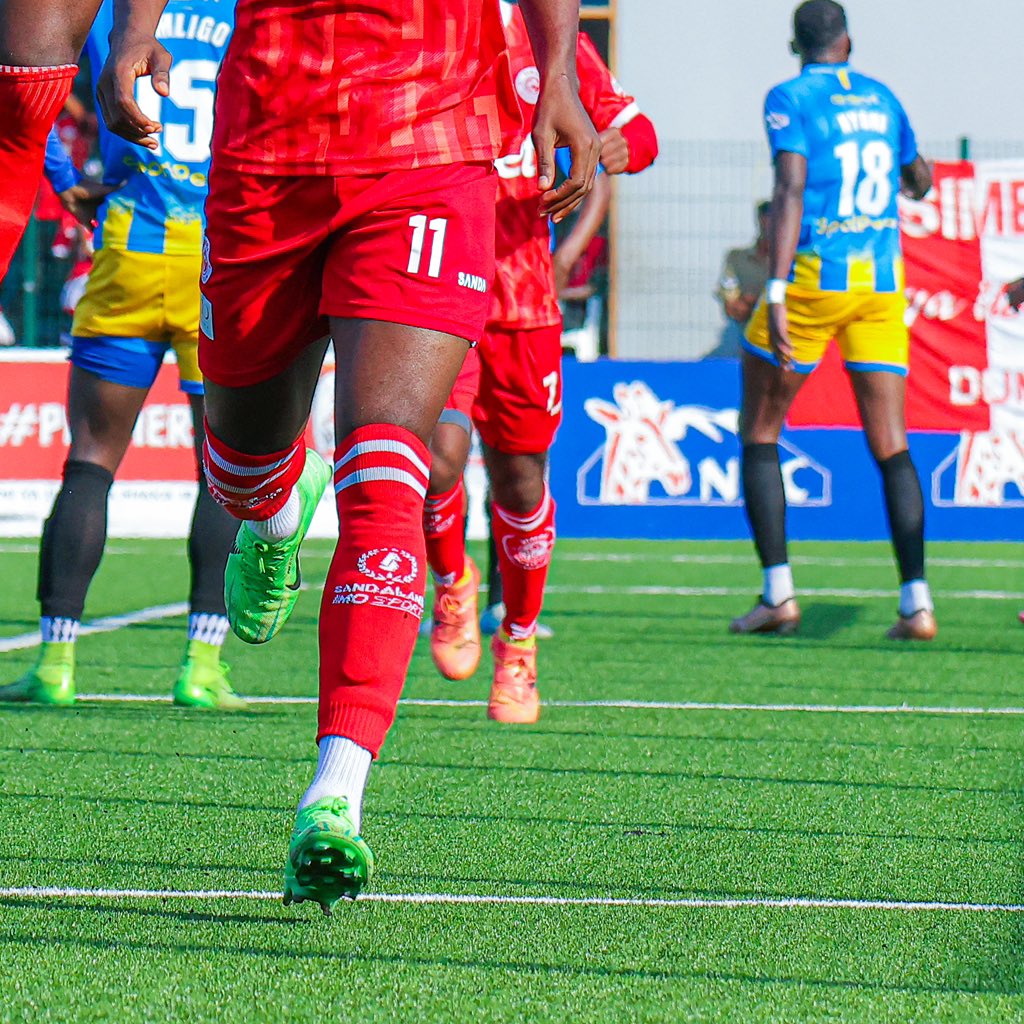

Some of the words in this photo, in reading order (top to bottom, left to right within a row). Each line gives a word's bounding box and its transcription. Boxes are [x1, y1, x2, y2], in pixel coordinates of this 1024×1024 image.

[833, 141, 893, 217] 18
[407, 214, 447, 278] 11
[457, 271, 487, 293] SANDA
[697, 456, 809, 504] NC
